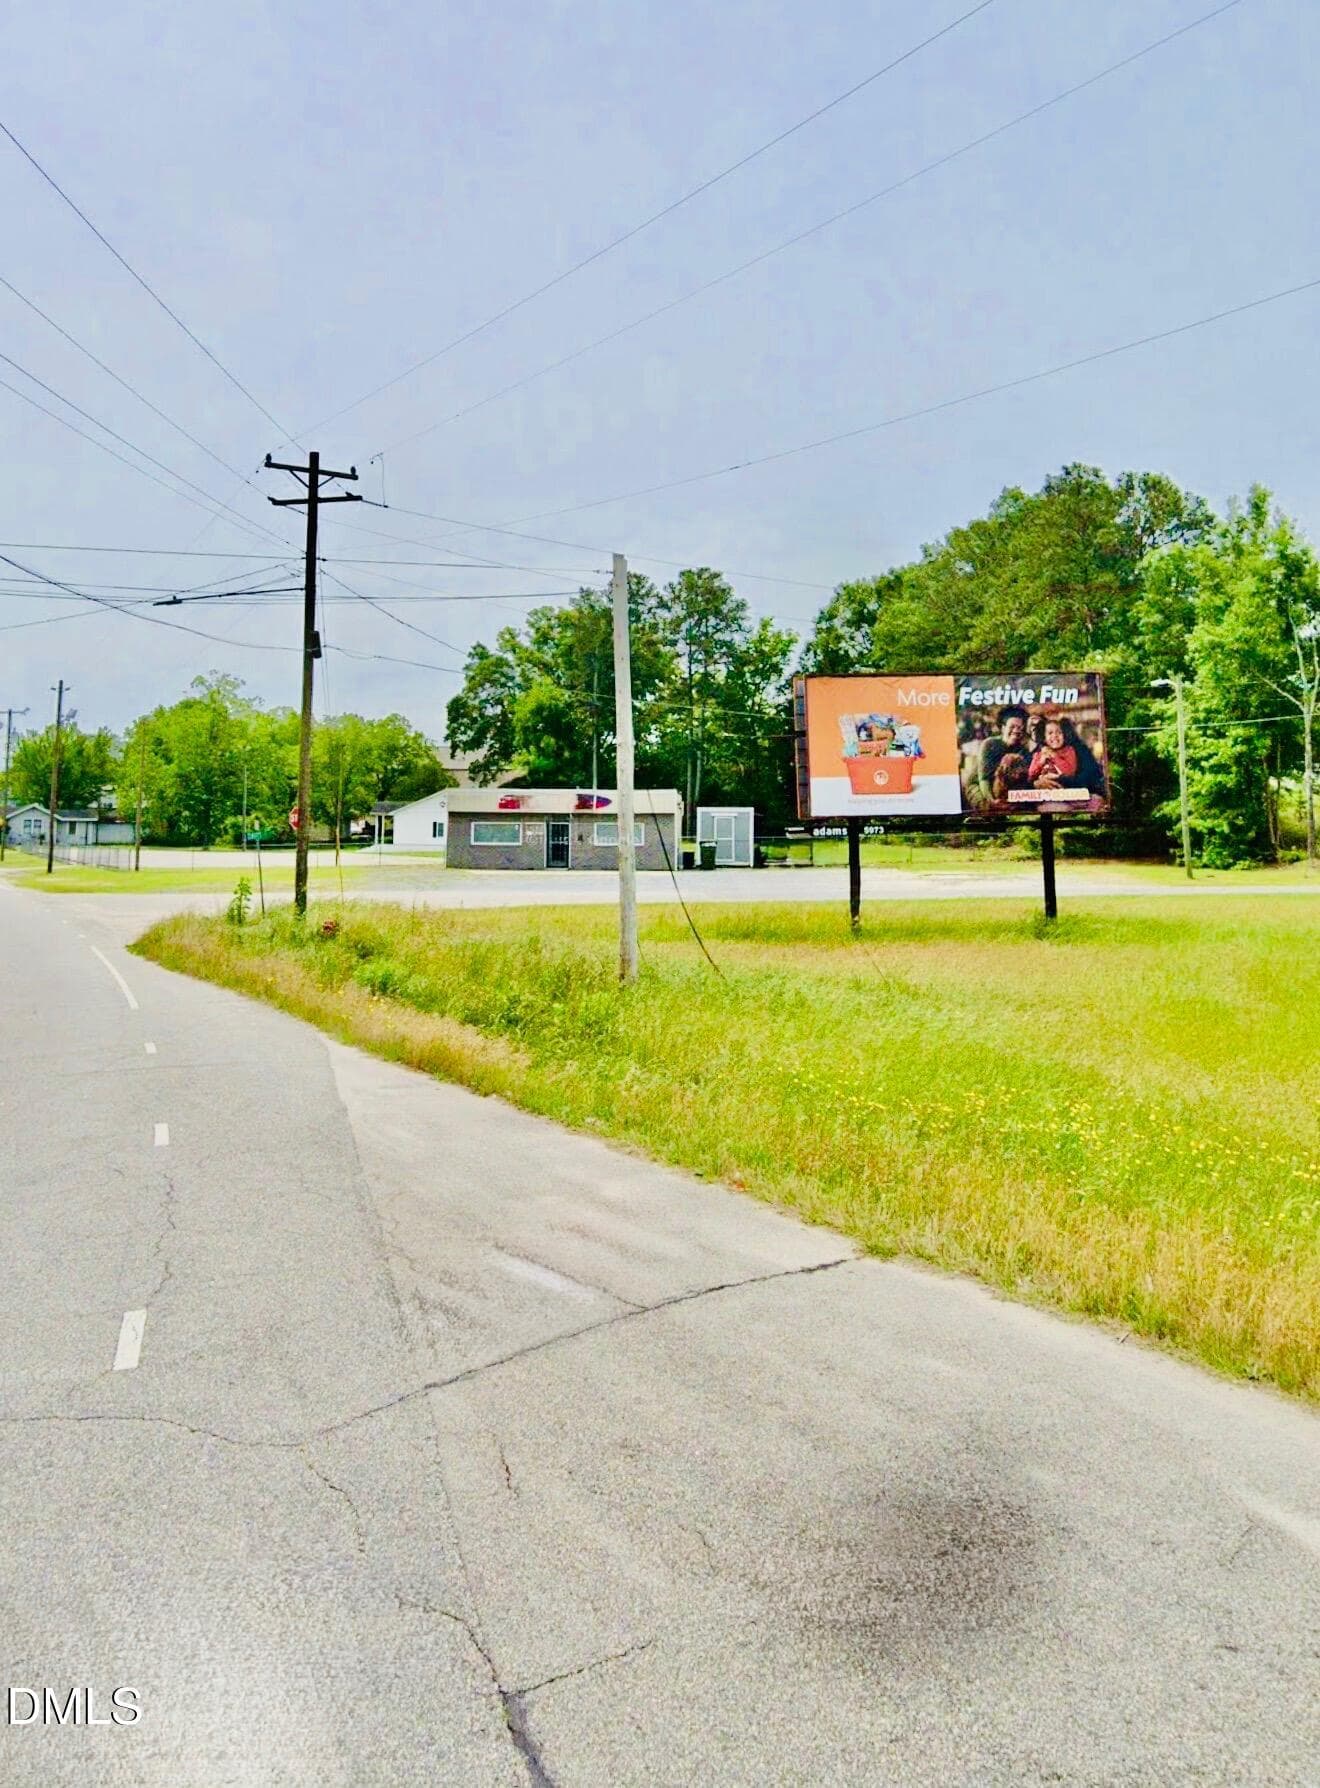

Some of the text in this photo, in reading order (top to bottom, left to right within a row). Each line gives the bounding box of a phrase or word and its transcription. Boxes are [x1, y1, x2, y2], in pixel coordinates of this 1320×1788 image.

[897, 685, 1079, 706] More Festive Fun
[1010, 791, 1041, 801] FAMILY
[813, 826, 848, 836] adams
